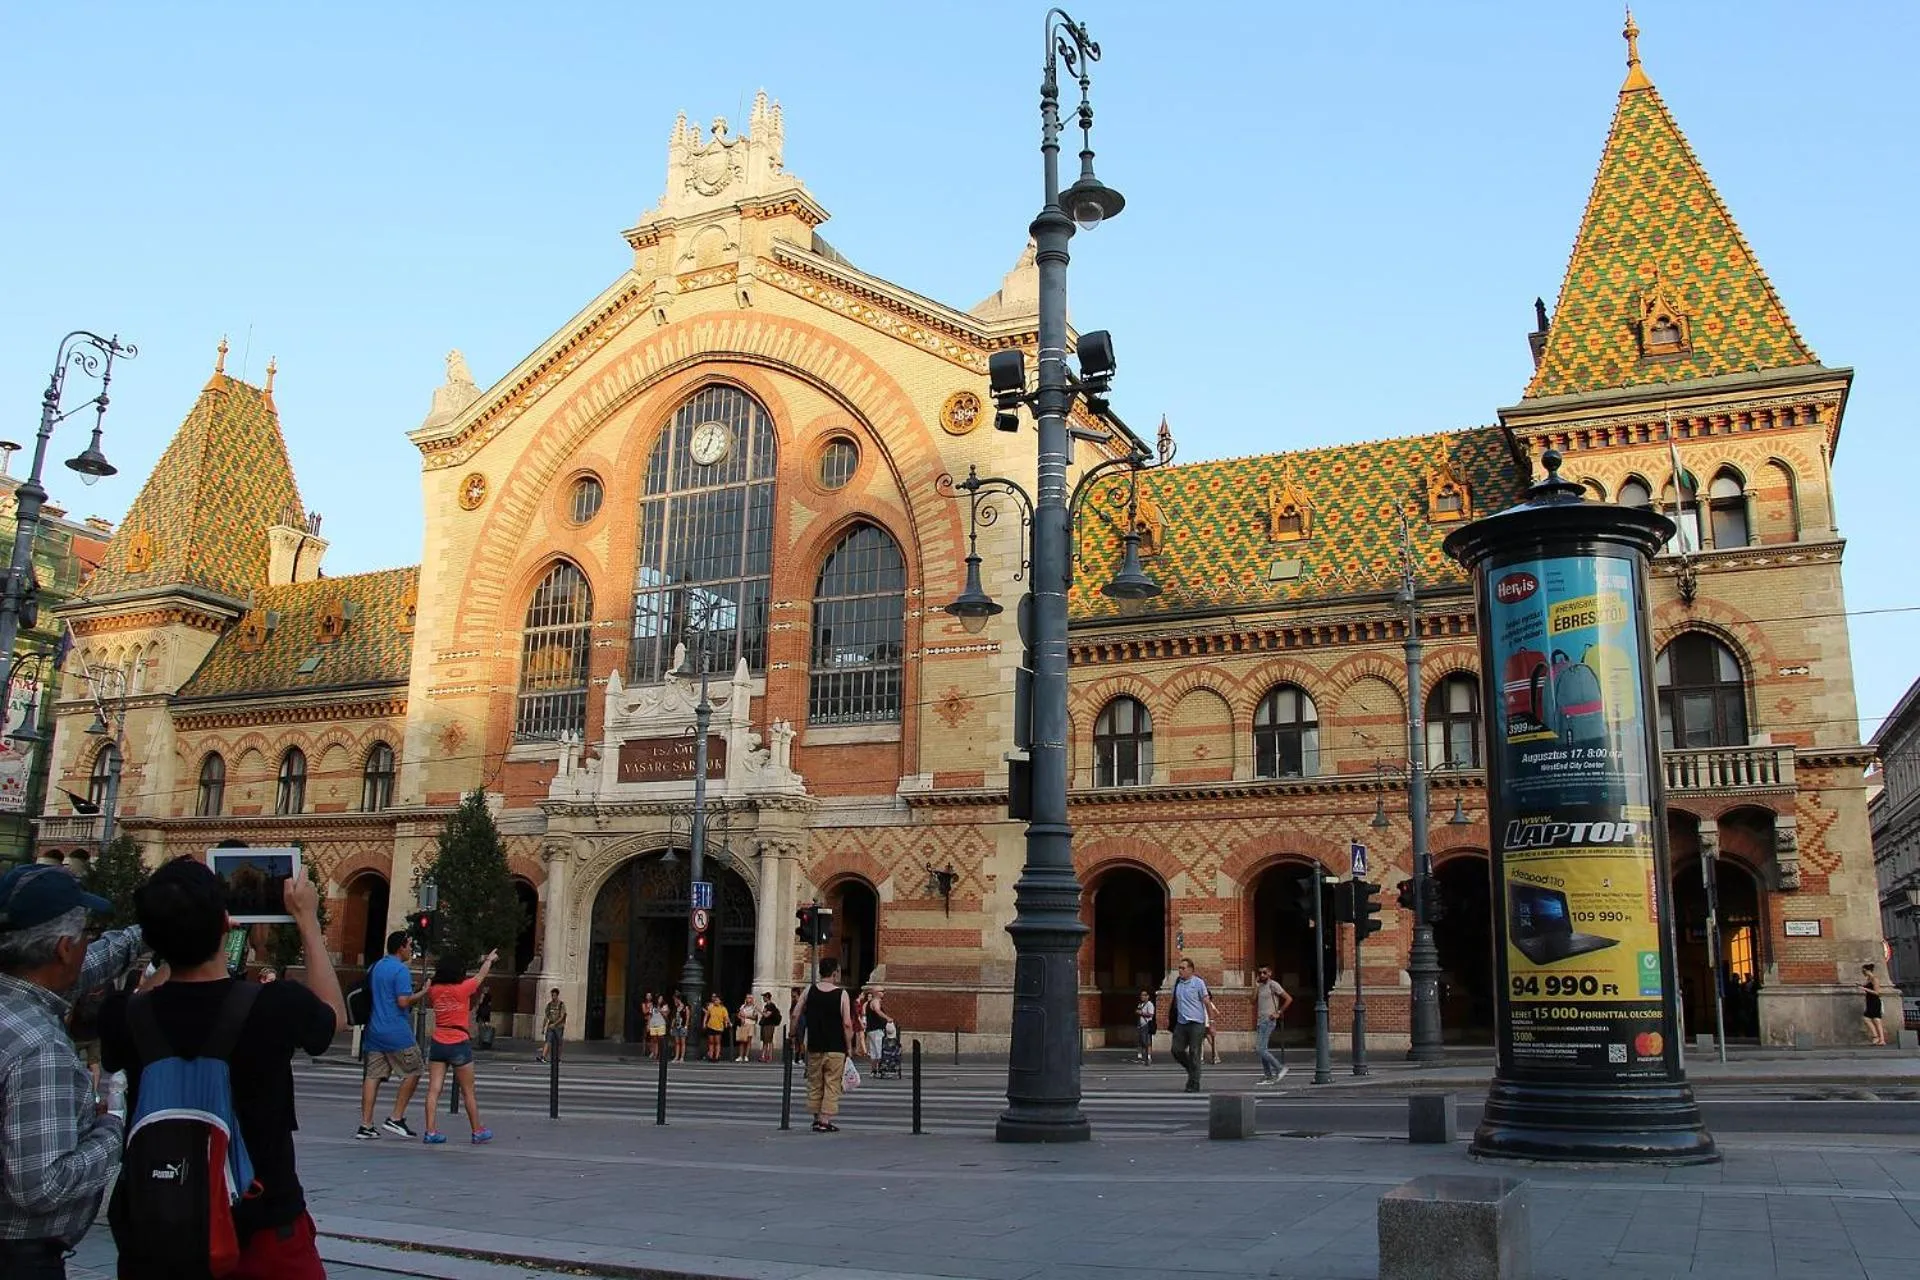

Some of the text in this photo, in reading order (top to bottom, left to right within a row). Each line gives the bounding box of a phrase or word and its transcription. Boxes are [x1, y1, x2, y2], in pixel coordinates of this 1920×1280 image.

[1498, 579, 1535, 597] Hervis
[1521, 750, 1567, 763] Augusztus
[1570, 748, 1585, 759] 17.
[1587, 748, 1607, 759] 8:00
[1569, 761, 1582, 770] City
[1583, 761, 1605, 769] Center
[1504, 820, 1638, 849] LAPTOP
[1511, 867, 1565, 888] ideapad 110
[1572, 912, 1595, 922] 109
[1599, 912, 1624, 922] 990
[1512, 975, 1619, 996] 94 990 Ft
[1511, 1010, 1532, 1019] LEHET
[1533, 1007, 1549, 1019] 15
[1551, 1007, 1579, 1019] 000
[1580, 1010, 1628, 1019] FORINTTAL
